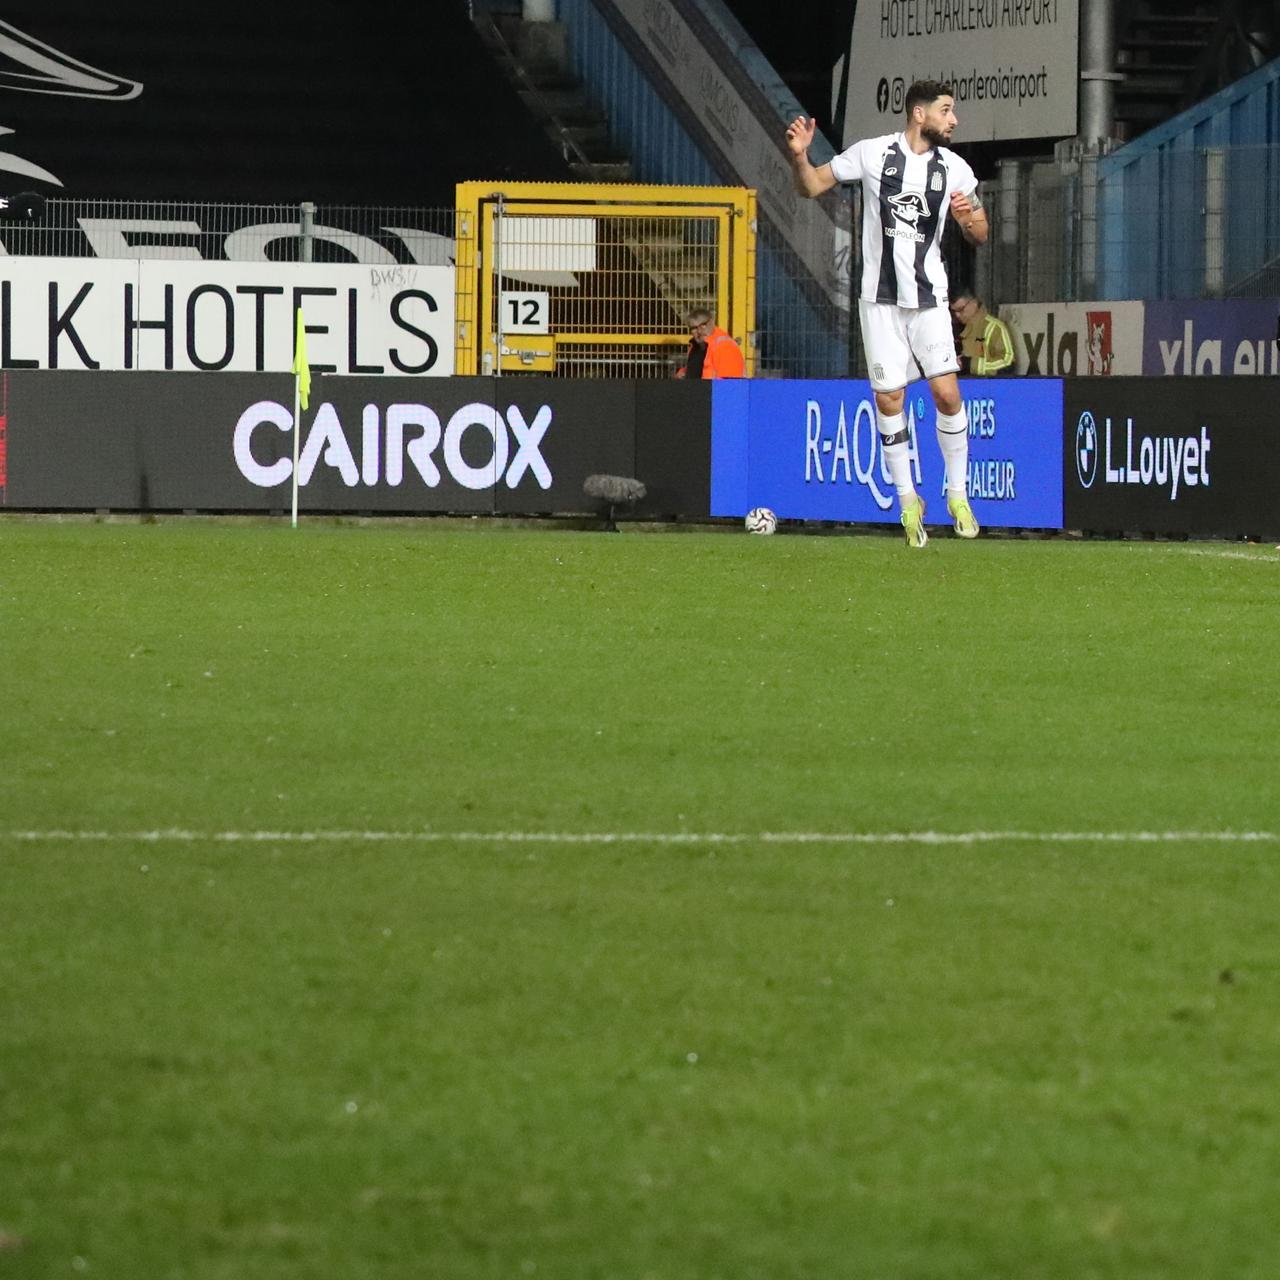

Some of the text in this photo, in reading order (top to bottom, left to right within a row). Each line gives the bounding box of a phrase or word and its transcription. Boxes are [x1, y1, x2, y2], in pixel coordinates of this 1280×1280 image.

[884, 227, 926, 242] NAPOLEON
[124, 282, 440, 374] HOTELS
[508, 299, 541, 326] 12
[233, 400, 554, 491] CAIROX
[1105, 418, 1211, 500] L.Louyet
[965, 459, 1016, 499] HALEUR
